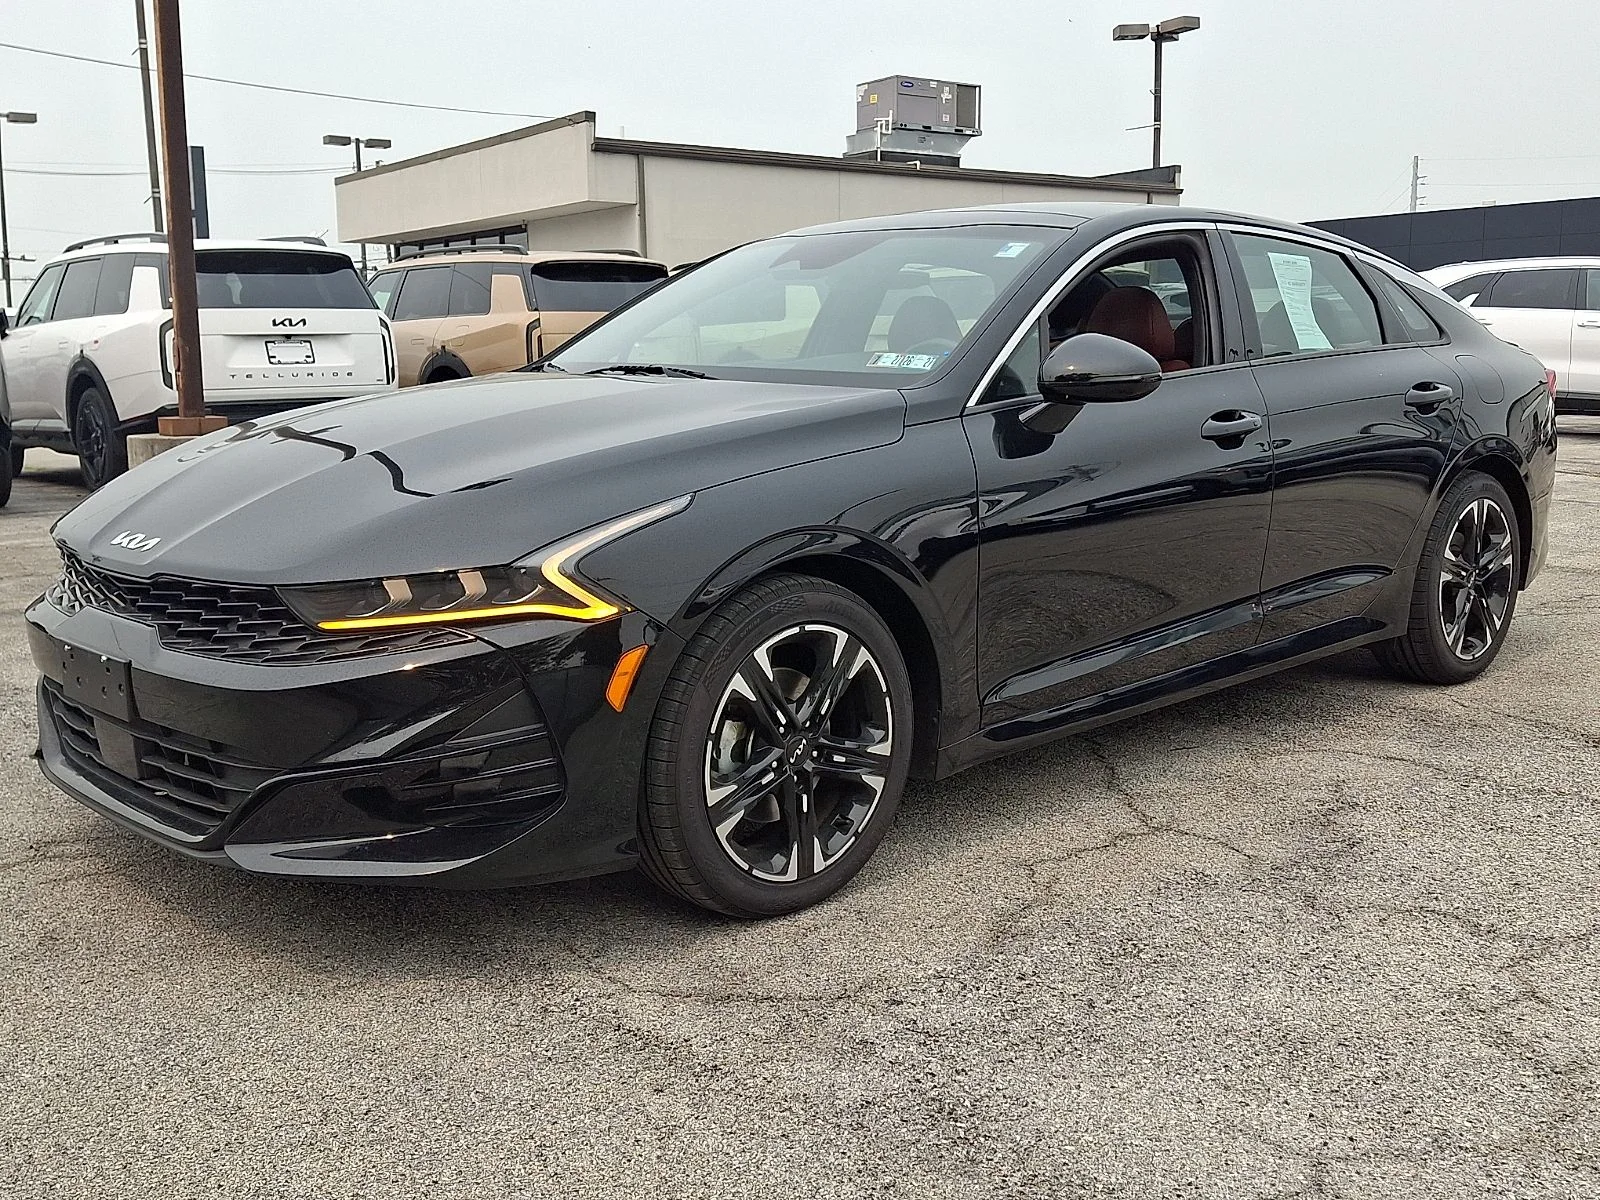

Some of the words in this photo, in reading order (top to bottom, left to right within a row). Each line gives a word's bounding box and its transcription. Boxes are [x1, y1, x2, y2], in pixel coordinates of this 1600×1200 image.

[272, 318, 306, 327] KIA
[229, 371, 353, 380] TELLURIDE
[110, 530, 162, 552] KIA
